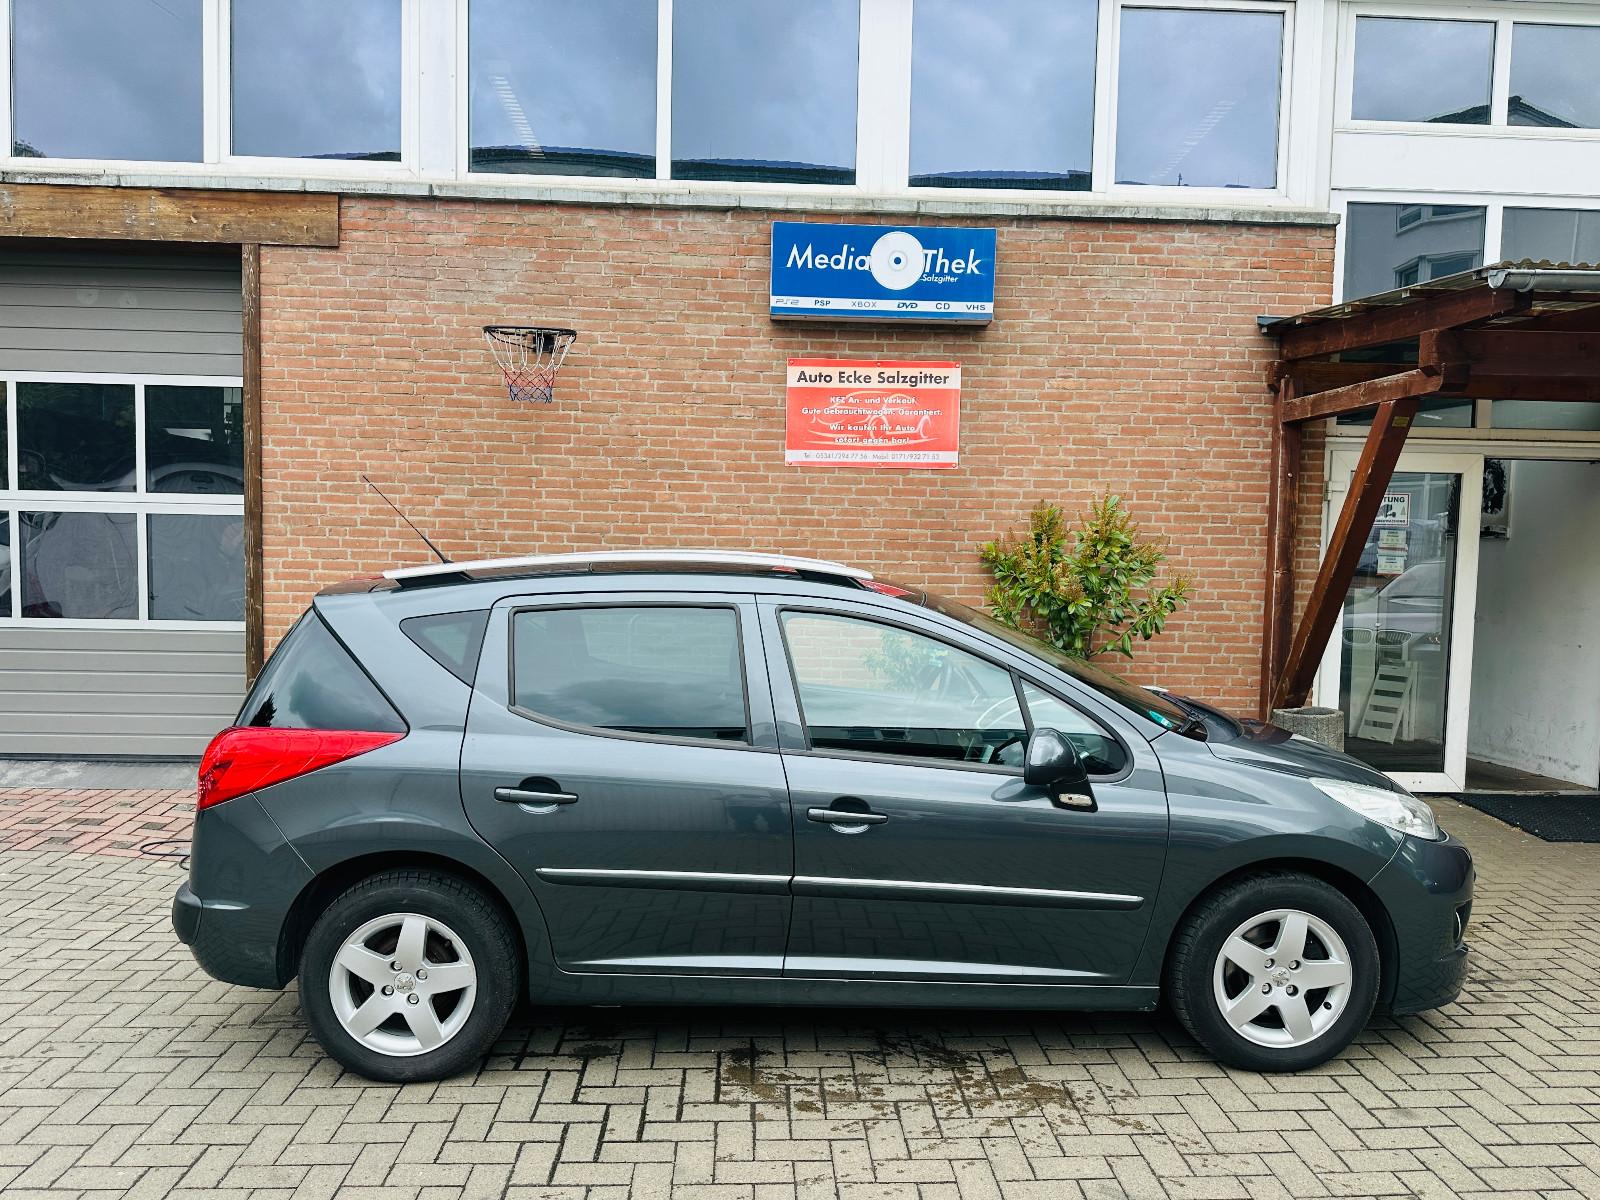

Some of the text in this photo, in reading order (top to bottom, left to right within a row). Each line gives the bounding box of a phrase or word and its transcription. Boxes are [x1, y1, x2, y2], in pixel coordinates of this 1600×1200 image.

[786, 243, 982, 275] Media Thek
[922, 274, 959, 284] Salzgitter
[814, 299, 831, 307] PSP
[935, 302, 951, 310] CD
[796, 371, 949, 387] Auto Ecke Salzgitter
[848, 396, 862, 404] An-
[865, 396, 880, 404] und
[880, 424, 892, 432] Ihr
[895, 424, 915, 432] Auto
[863, 438, 888, 446] gegen
